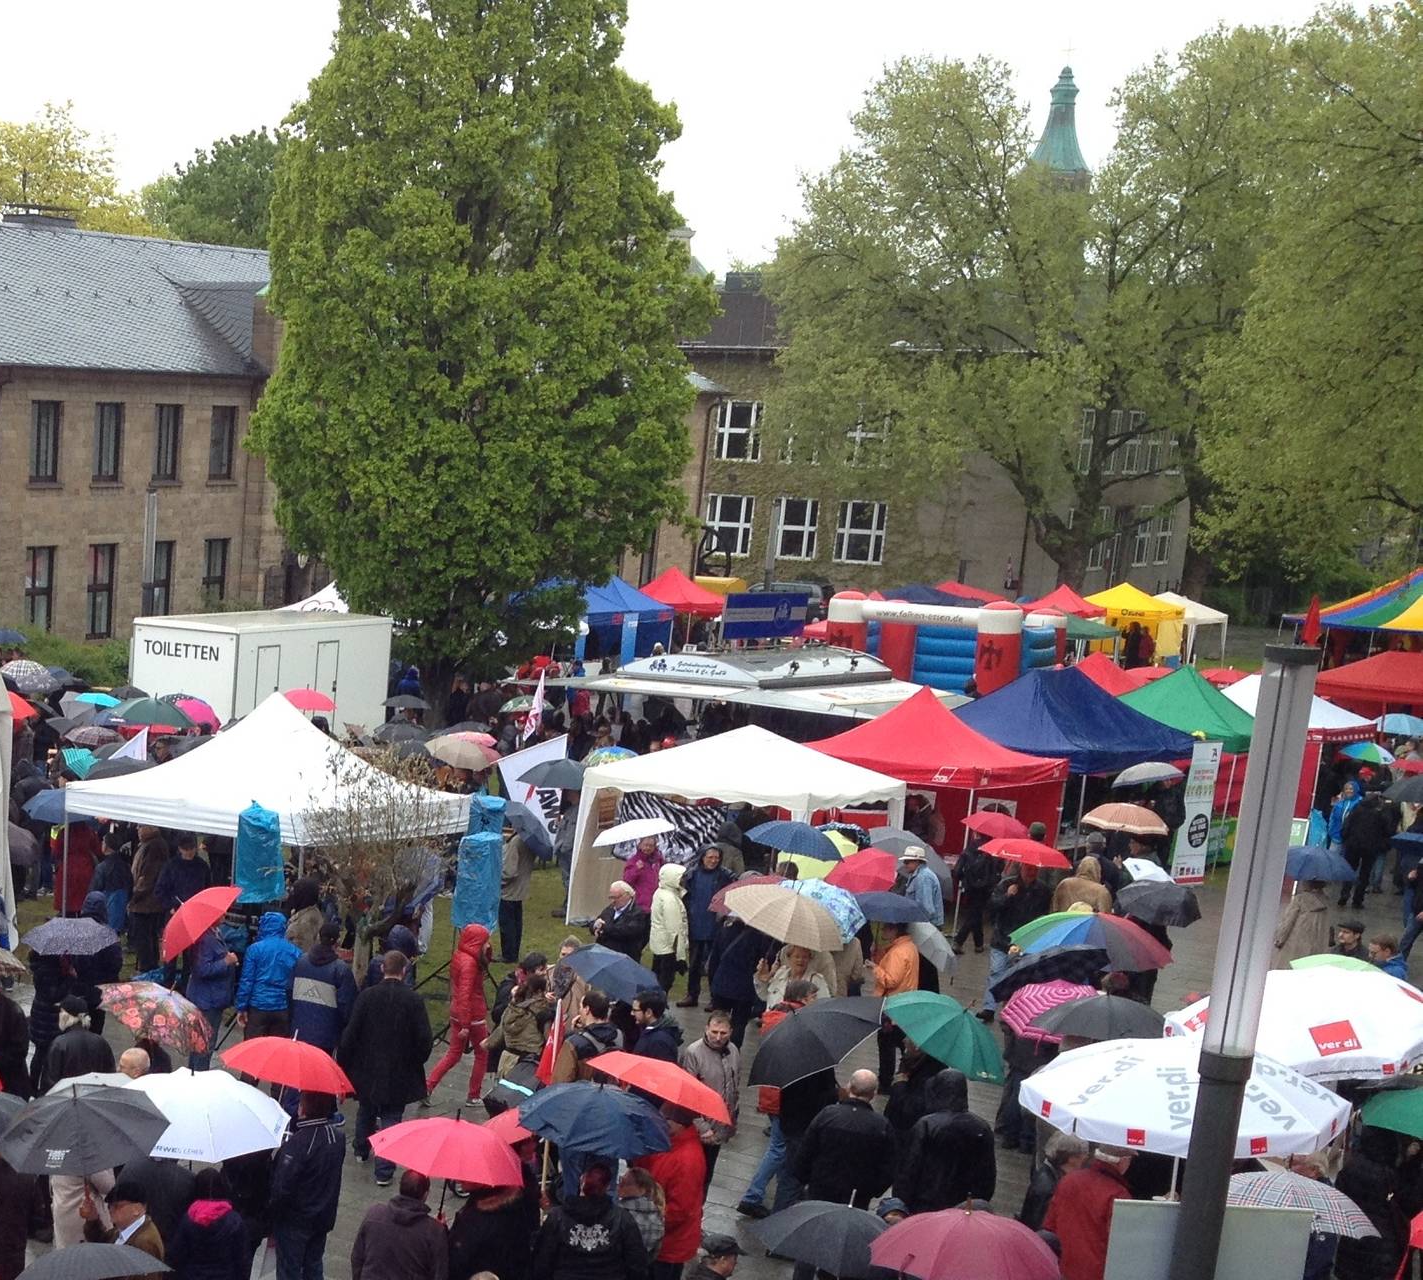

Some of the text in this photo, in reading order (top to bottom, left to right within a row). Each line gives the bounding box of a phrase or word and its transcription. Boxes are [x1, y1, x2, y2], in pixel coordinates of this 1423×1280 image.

[144, 638, 220, 663] TOILETTEN
[1317, 1038, 1358, 1050] ver.di
[1068, 1055, 1146, 1107] ver.di
[1156, 1066, 1192, 1132] ver.di
